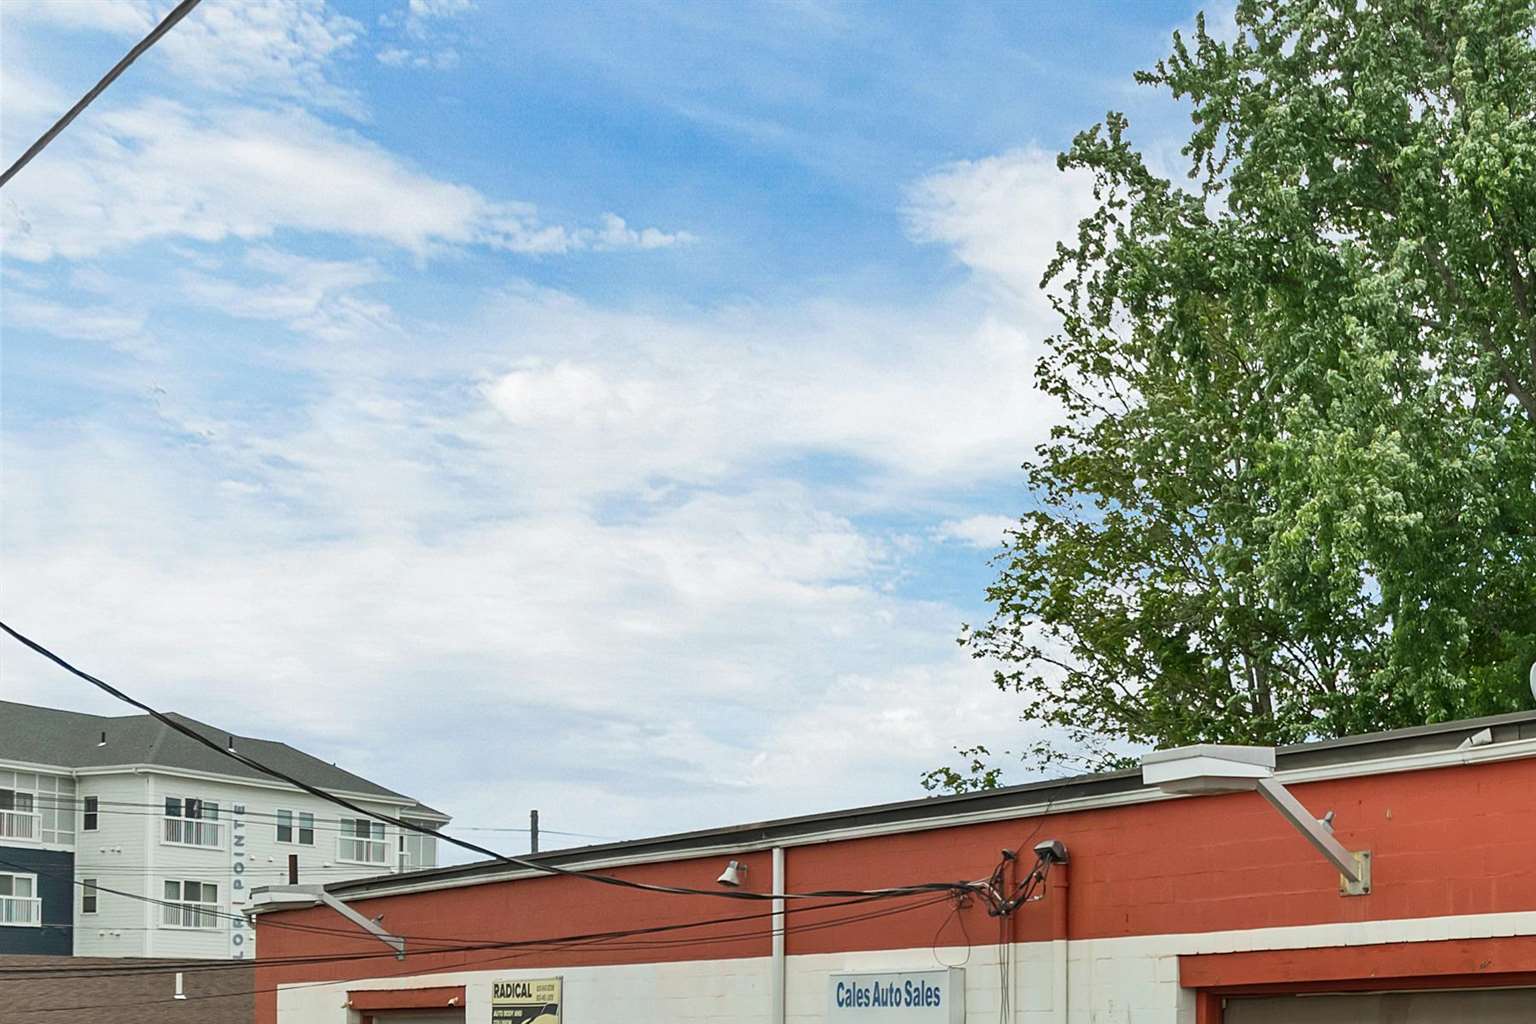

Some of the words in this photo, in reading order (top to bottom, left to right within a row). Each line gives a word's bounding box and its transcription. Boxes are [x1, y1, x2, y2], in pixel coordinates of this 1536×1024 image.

[233, 804, 245, 890] POINTE
[493, 983, 532, 998] RADICAL
[836, 982, 871, 1007] Cales
[872, 981, 902, 1007] Auto
[904, 980, 941, 1007] Sales
